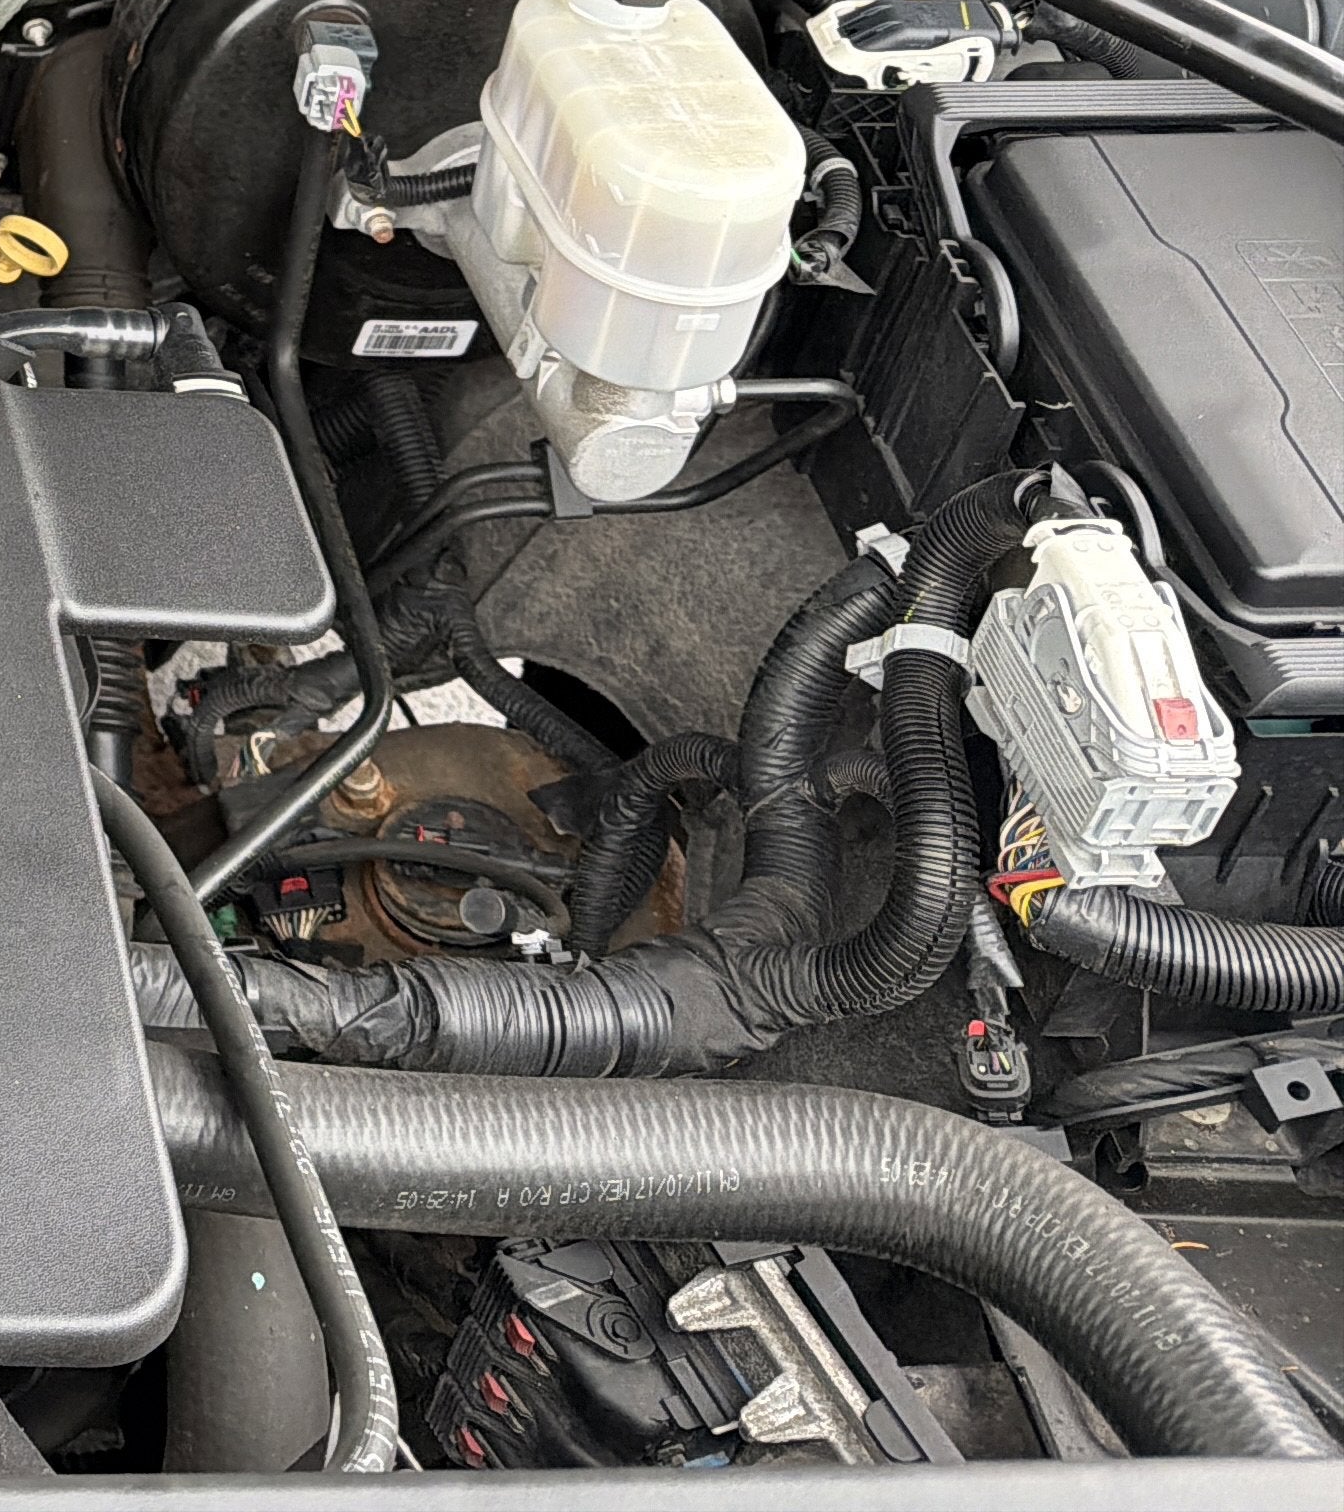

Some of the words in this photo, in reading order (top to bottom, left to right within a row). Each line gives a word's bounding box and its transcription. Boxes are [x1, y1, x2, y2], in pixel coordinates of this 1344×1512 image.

[597, 1179, 630, 1202] MEX
[635, 1170, 712, 1200] 11/10/17
[394, 1188, 476, 1210] 14:29:05
